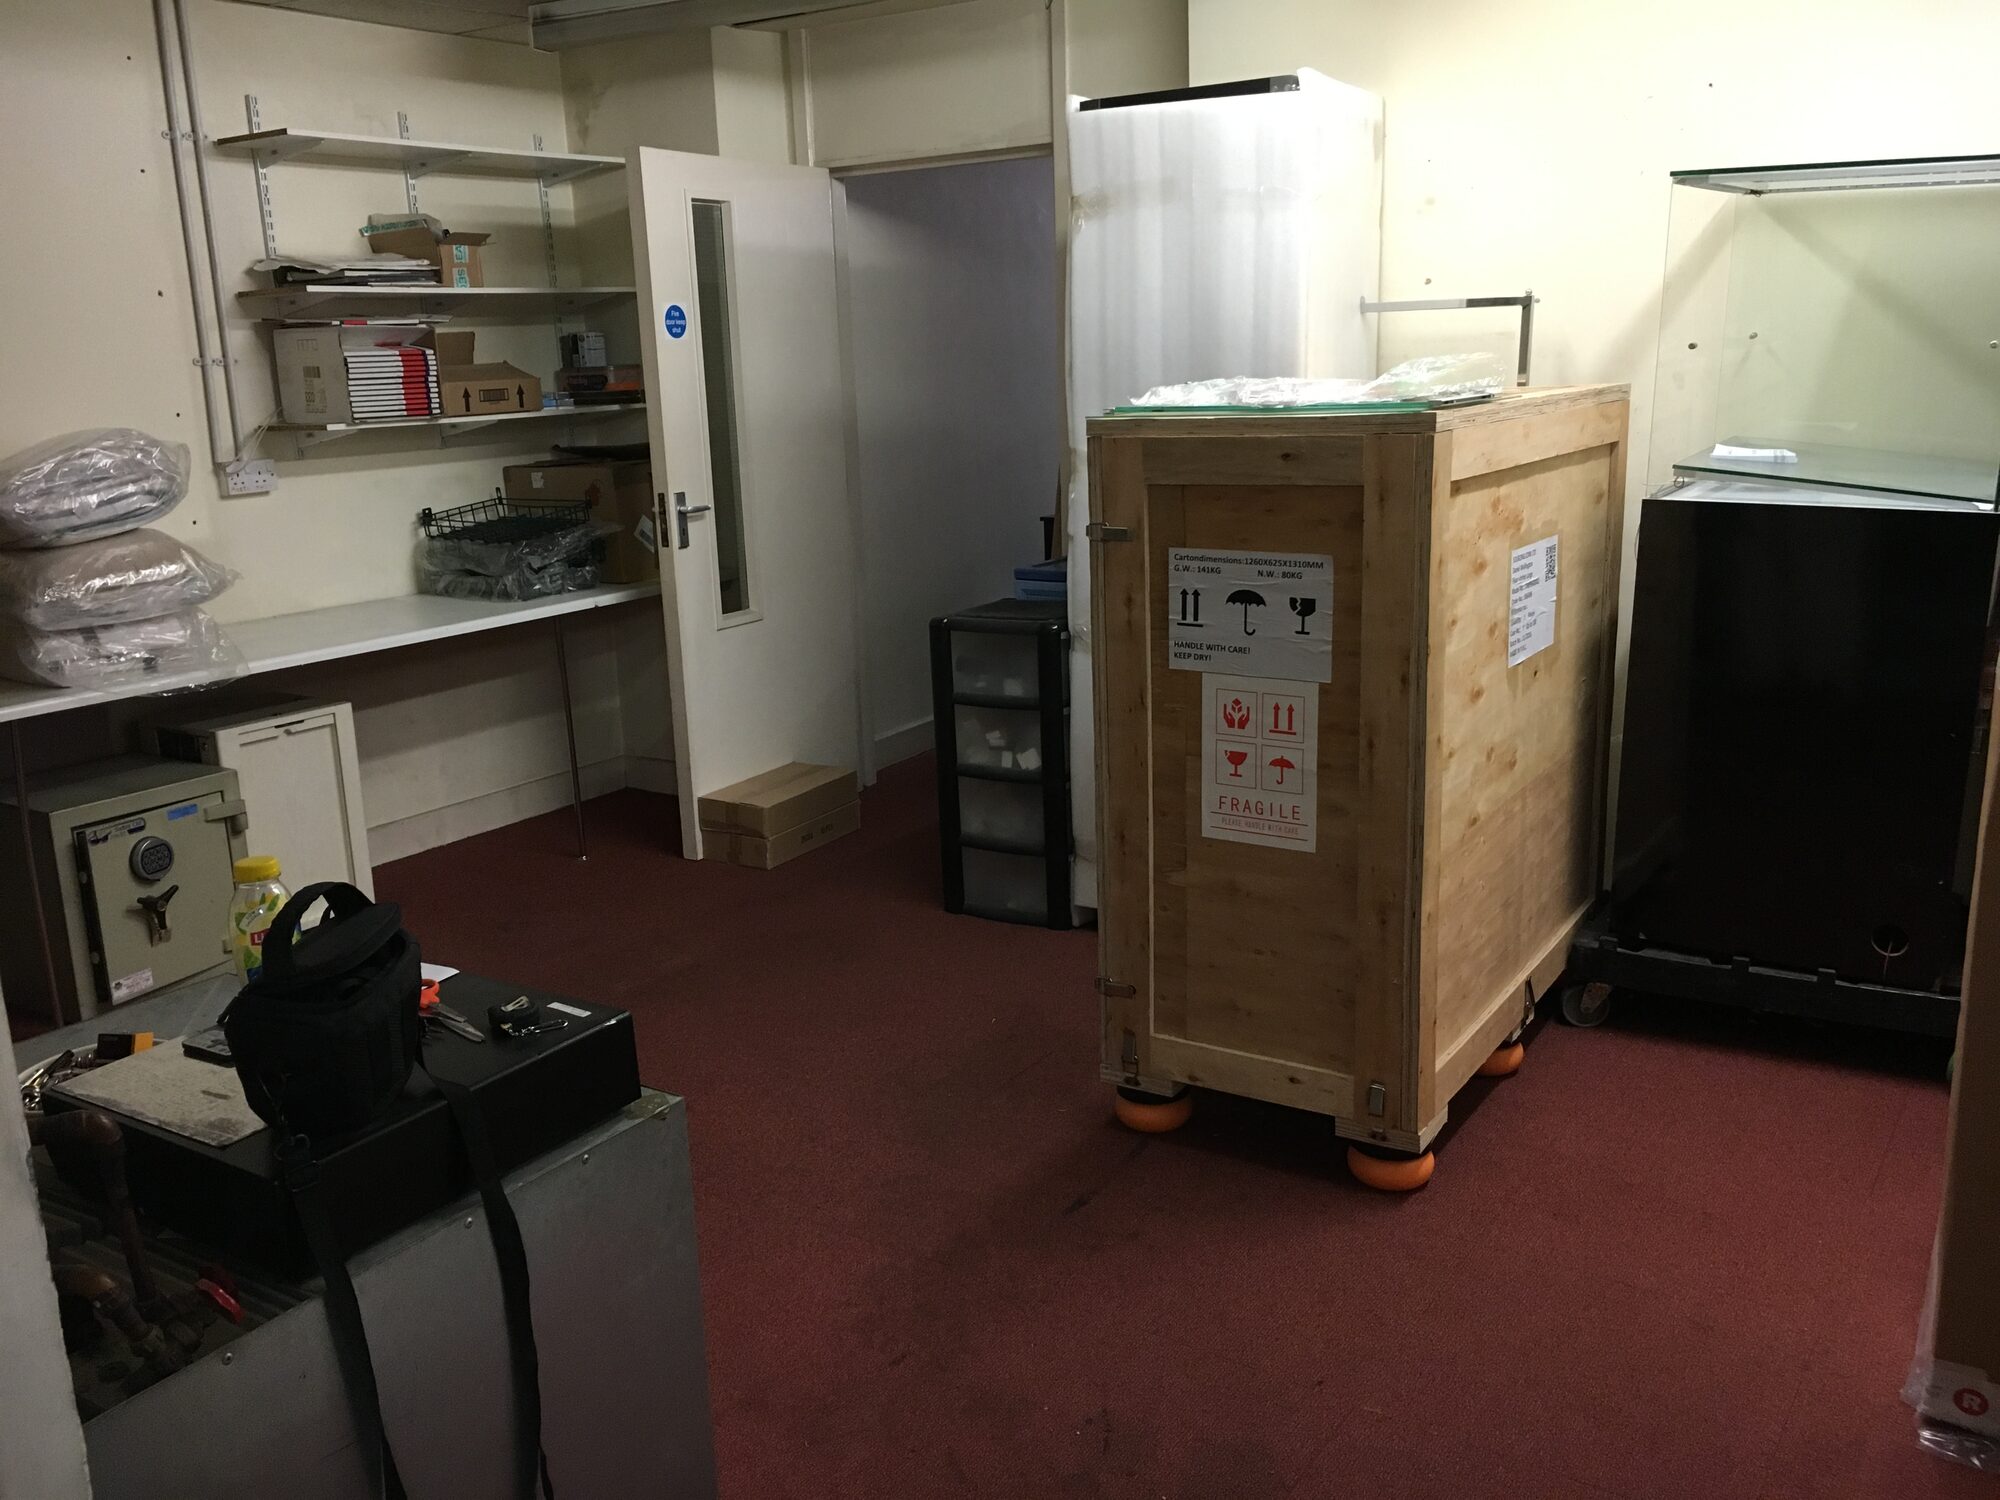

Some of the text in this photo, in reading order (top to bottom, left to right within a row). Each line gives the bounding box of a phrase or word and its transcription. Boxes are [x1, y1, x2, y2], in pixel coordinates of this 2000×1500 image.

[1173, 564, 1303, 580] G.W.: 141KG N.W.: 80KG
[1174, 641, 1251, 655] HANDLE WITH CARE!
[1173, 651, 1212, 662] KEEP DRY!
[1218, 796, 1301, 820] FRAGILE
